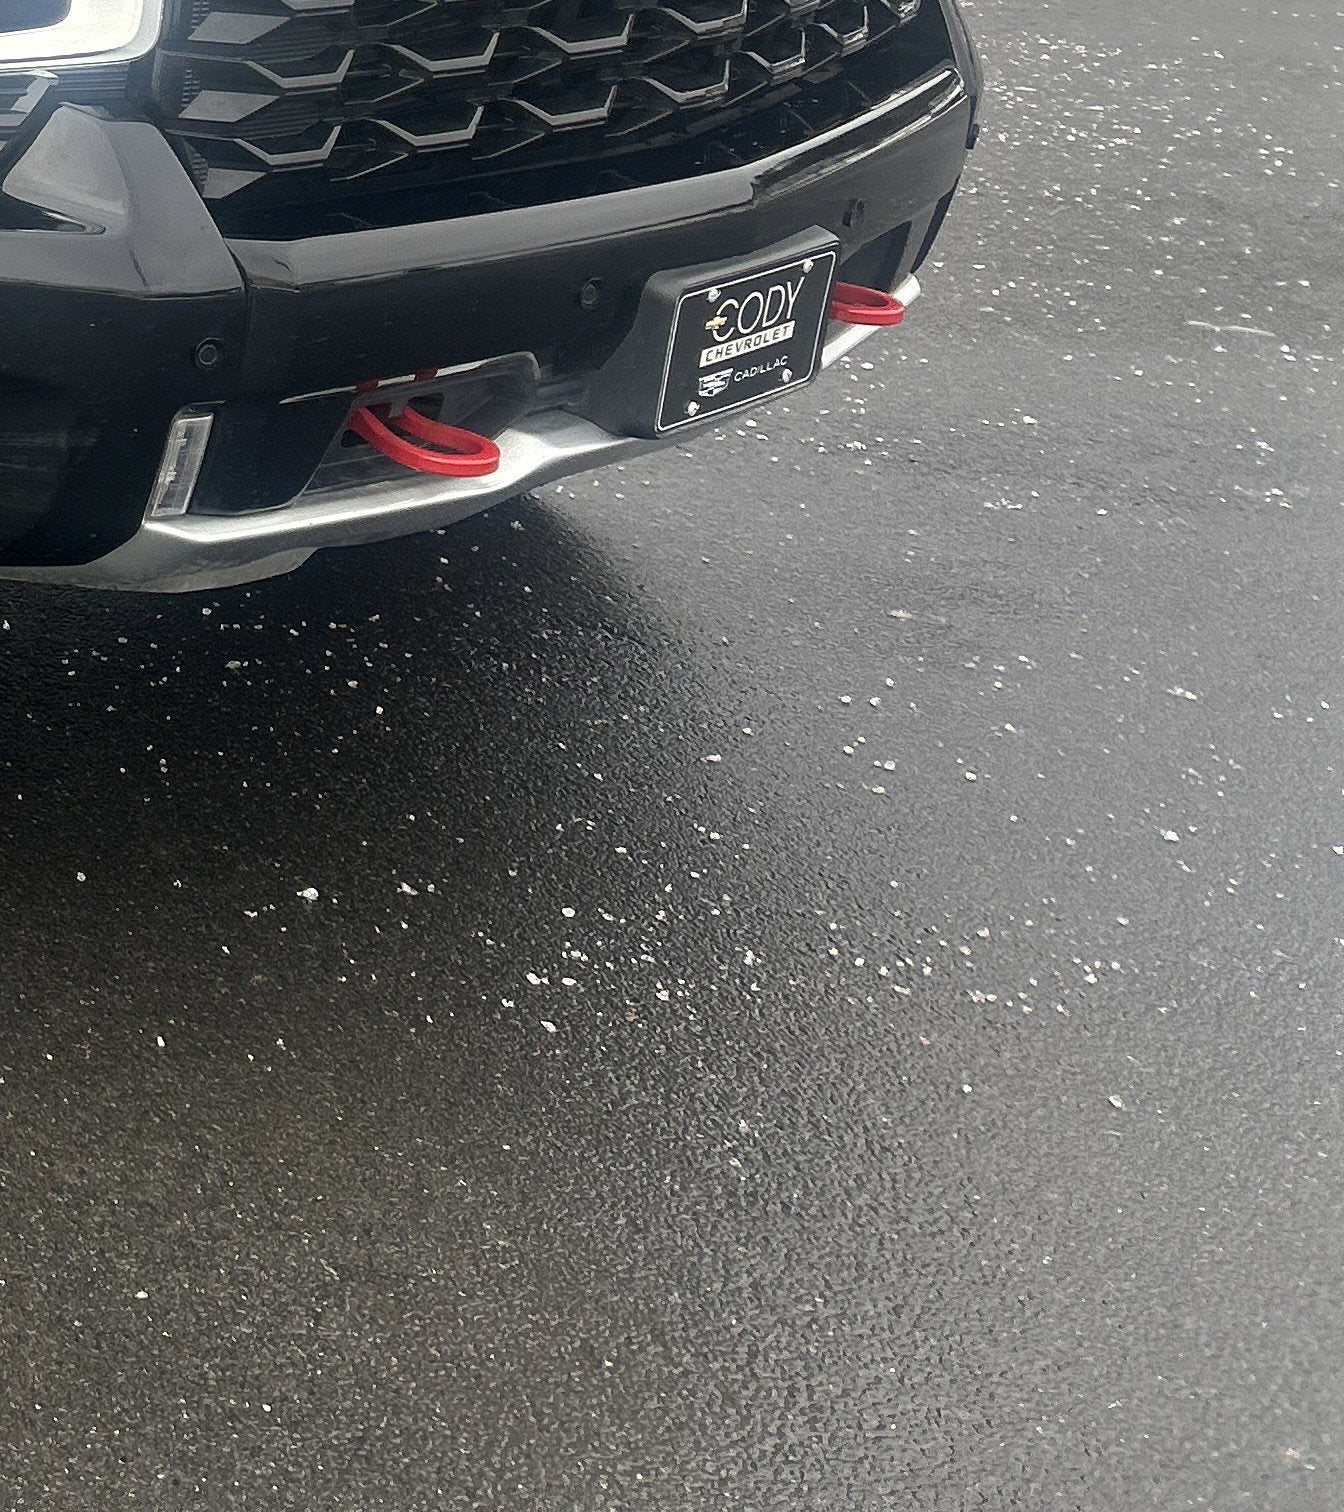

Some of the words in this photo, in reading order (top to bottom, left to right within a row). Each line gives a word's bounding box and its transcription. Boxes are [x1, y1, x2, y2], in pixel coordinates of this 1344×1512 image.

[708, 276, 805, 342] CODY
[705, 331, 789, 363] CHEVROLET
[733, 355, 788, 382] CADILLAC
